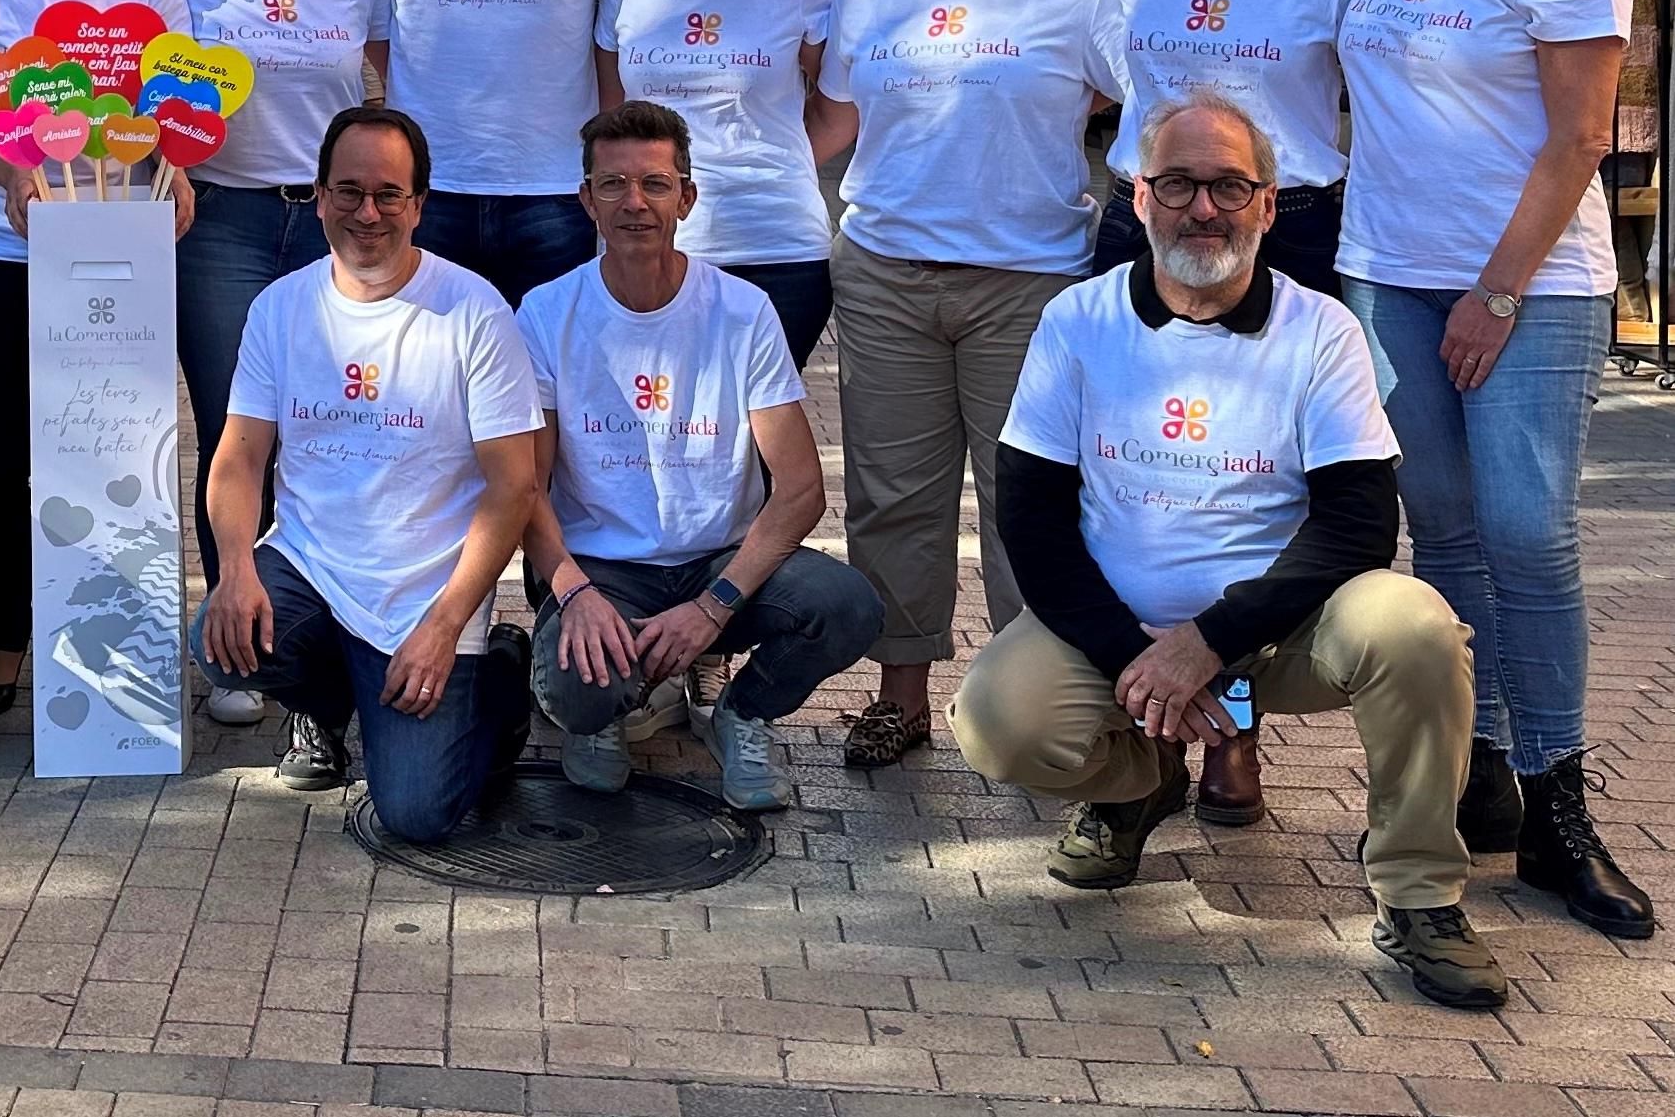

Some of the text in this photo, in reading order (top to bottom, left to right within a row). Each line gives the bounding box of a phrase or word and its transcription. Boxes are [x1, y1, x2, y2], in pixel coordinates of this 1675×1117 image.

[77, 22, 129, 38] Soc un
[238, 24, 350, 44] Comerçiada
[869, 36, 1021, 62] la Comerçiada
[1129, 30, 1282, 63] la Comerçiada
[88, 55, 138, 75] em fas
[183, 58, 207, 71] meu
[209, 64, 228, 76] cor
[628, 45, 772, 70] la Comerçiada
[27, 81, 56, 93] Sense
[91, 73, 125, 87] ran!
[220, 81, 237, 91] em
[42, 127, 82, 143] Amistat
[106, 129, 157, 143] Positivitat
[159, 117, 217, 145] Amabilitat
[48, 325, 156, 345] la Comerçiada
[290, 397, 425, 431] la Comerçiada
[583, 411, 721, 441] la Comerçiada
[1096, 433, 1276, 477] la Comerçiada
[1115, 483, 1142, 505] Que
